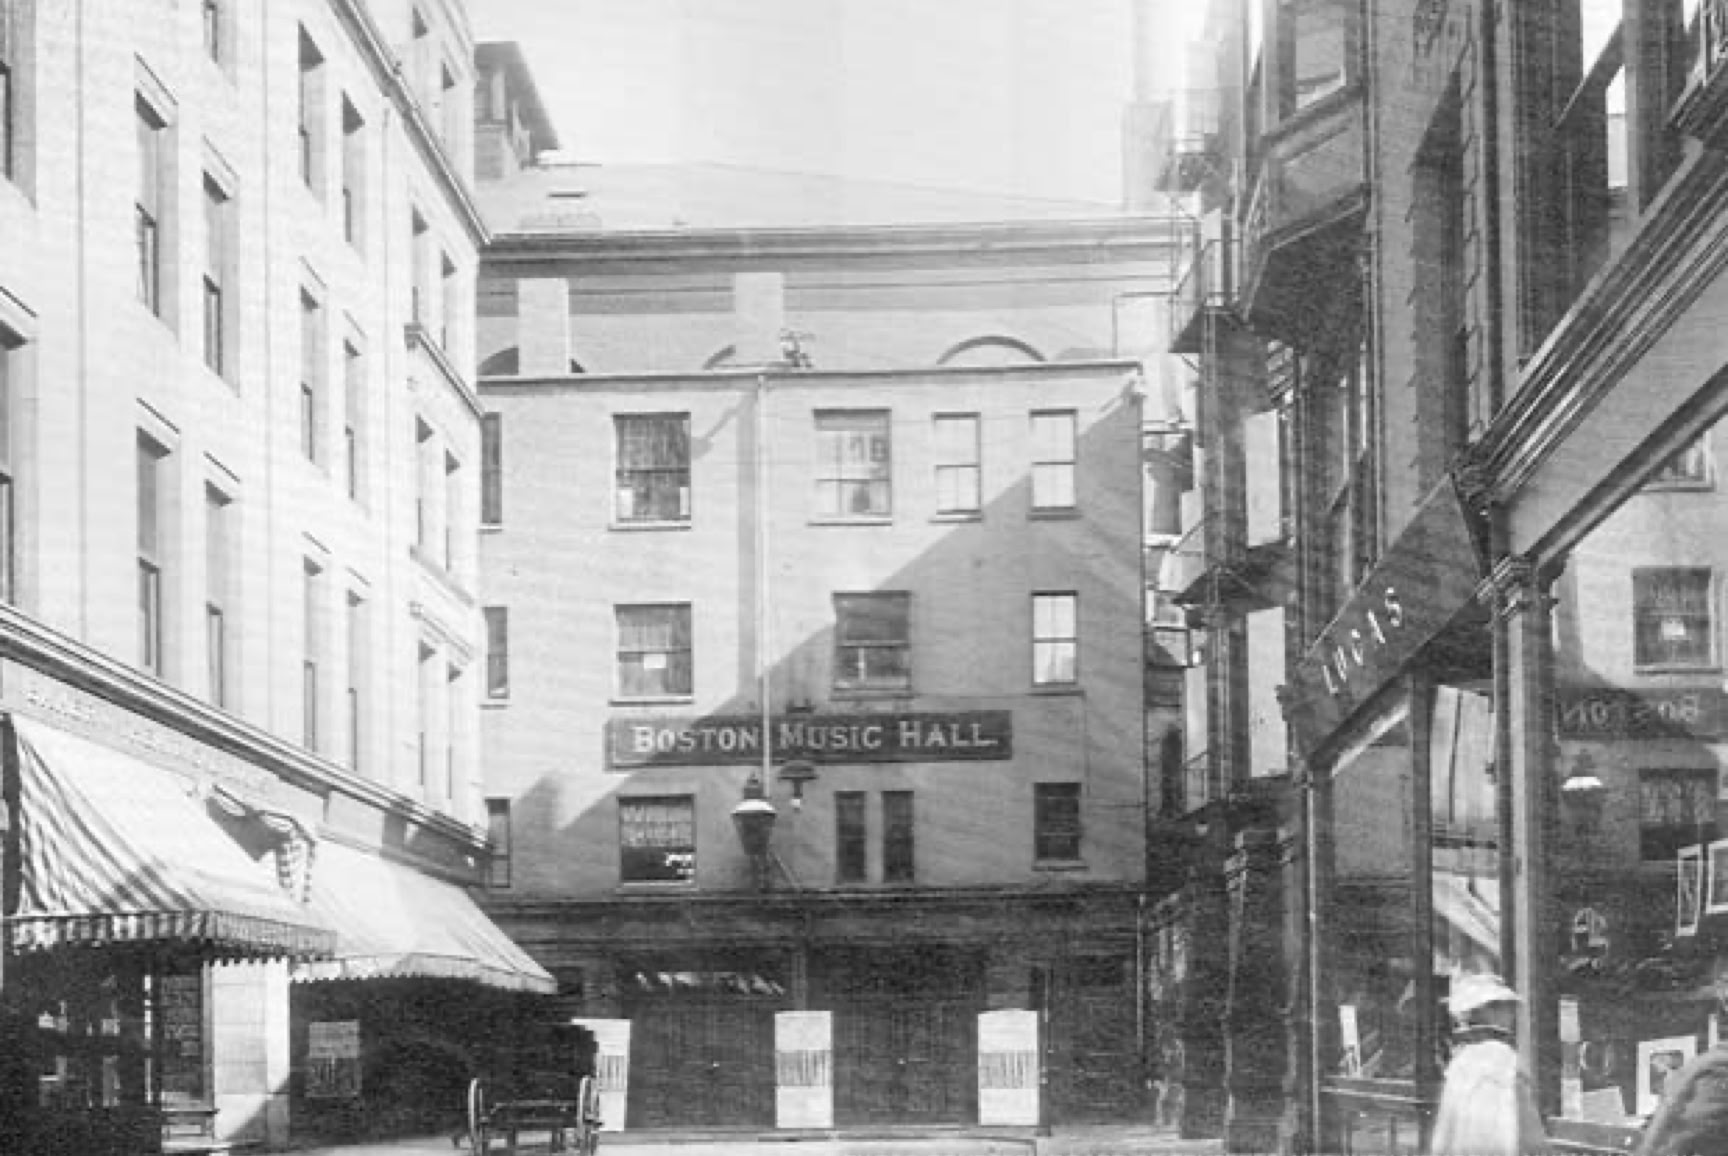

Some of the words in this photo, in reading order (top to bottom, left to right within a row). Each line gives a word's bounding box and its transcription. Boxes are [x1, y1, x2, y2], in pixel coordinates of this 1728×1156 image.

[632, 726, 759, 752] BOSTON
[780, 723, 882, 749] MUSIC
[899, 720, 998, 747] HALL
